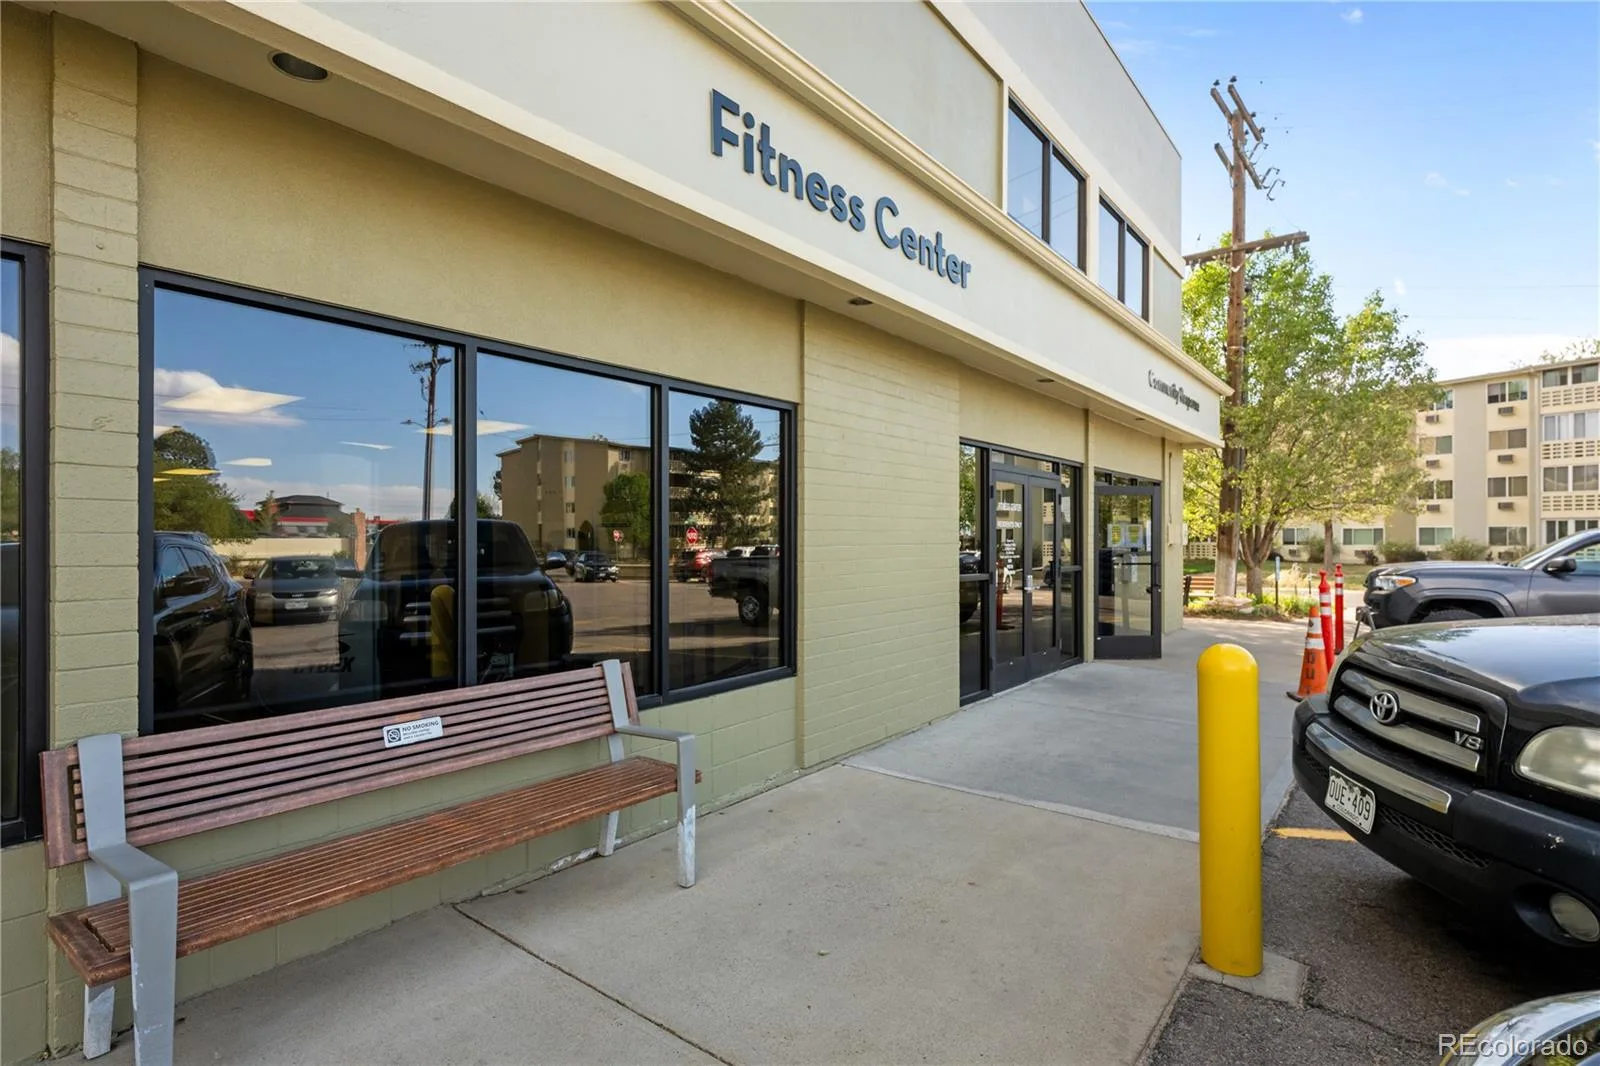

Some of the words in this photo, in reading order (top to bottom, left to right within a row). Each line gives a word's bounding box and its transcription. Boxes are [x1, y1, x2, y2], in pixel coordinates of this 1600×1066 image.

[710, 88, 866, 232] Fitness
[875, 196, 971, 288] Center
[412, 720, 439, 730] SMOKING
[1455, 730, 1481, 750] V8
